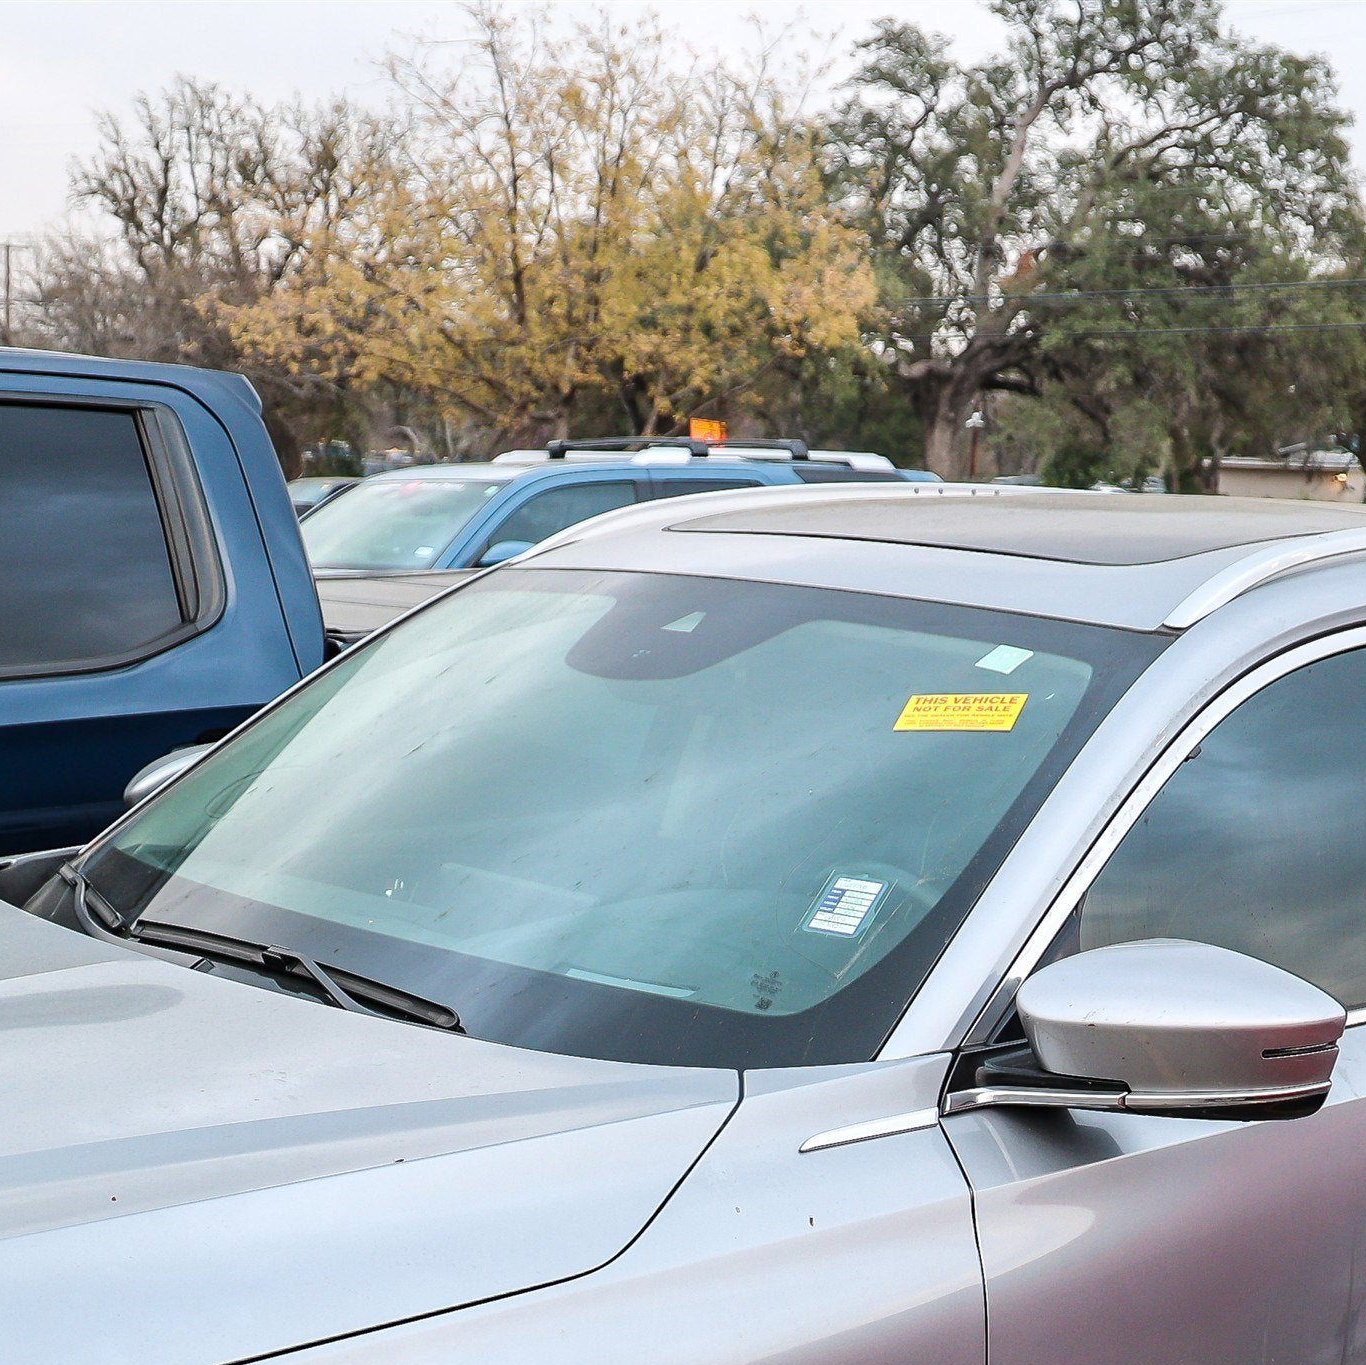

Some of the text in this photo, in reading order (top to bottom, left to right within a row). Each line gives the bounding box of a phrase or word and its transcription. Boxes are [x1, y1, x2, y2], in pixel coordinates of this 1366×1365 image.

[914, 695, 1021, 705] THIS VEHICLE
[912, 705, 941, 713] NOT
